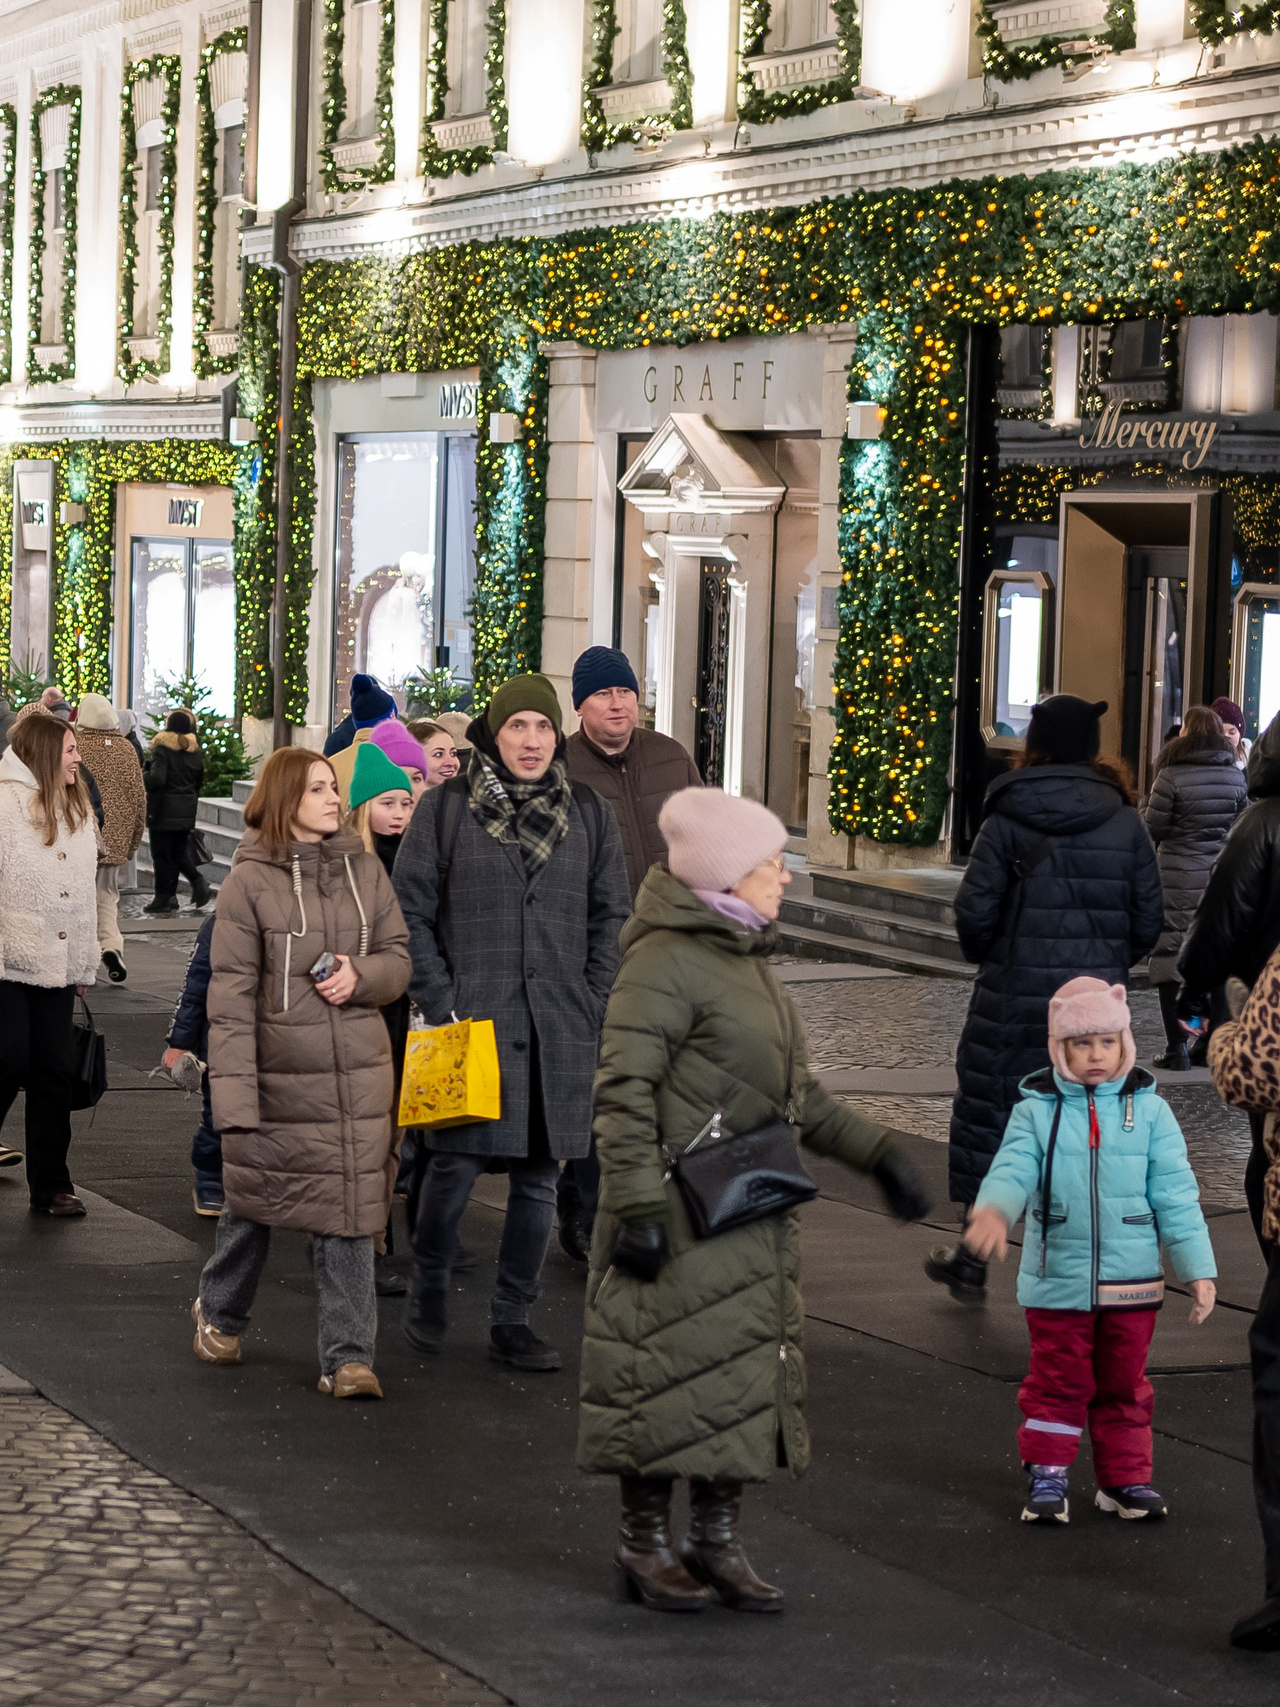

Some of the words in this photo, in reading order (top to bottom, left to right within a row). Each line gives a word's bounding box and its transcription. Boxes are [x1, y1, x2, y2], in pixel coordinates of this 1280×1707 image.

[439, 382, 480, 419] MVST
[643, 360, 775, 403] GRAFF
[1078, 398, 1221, 471] Mercury
